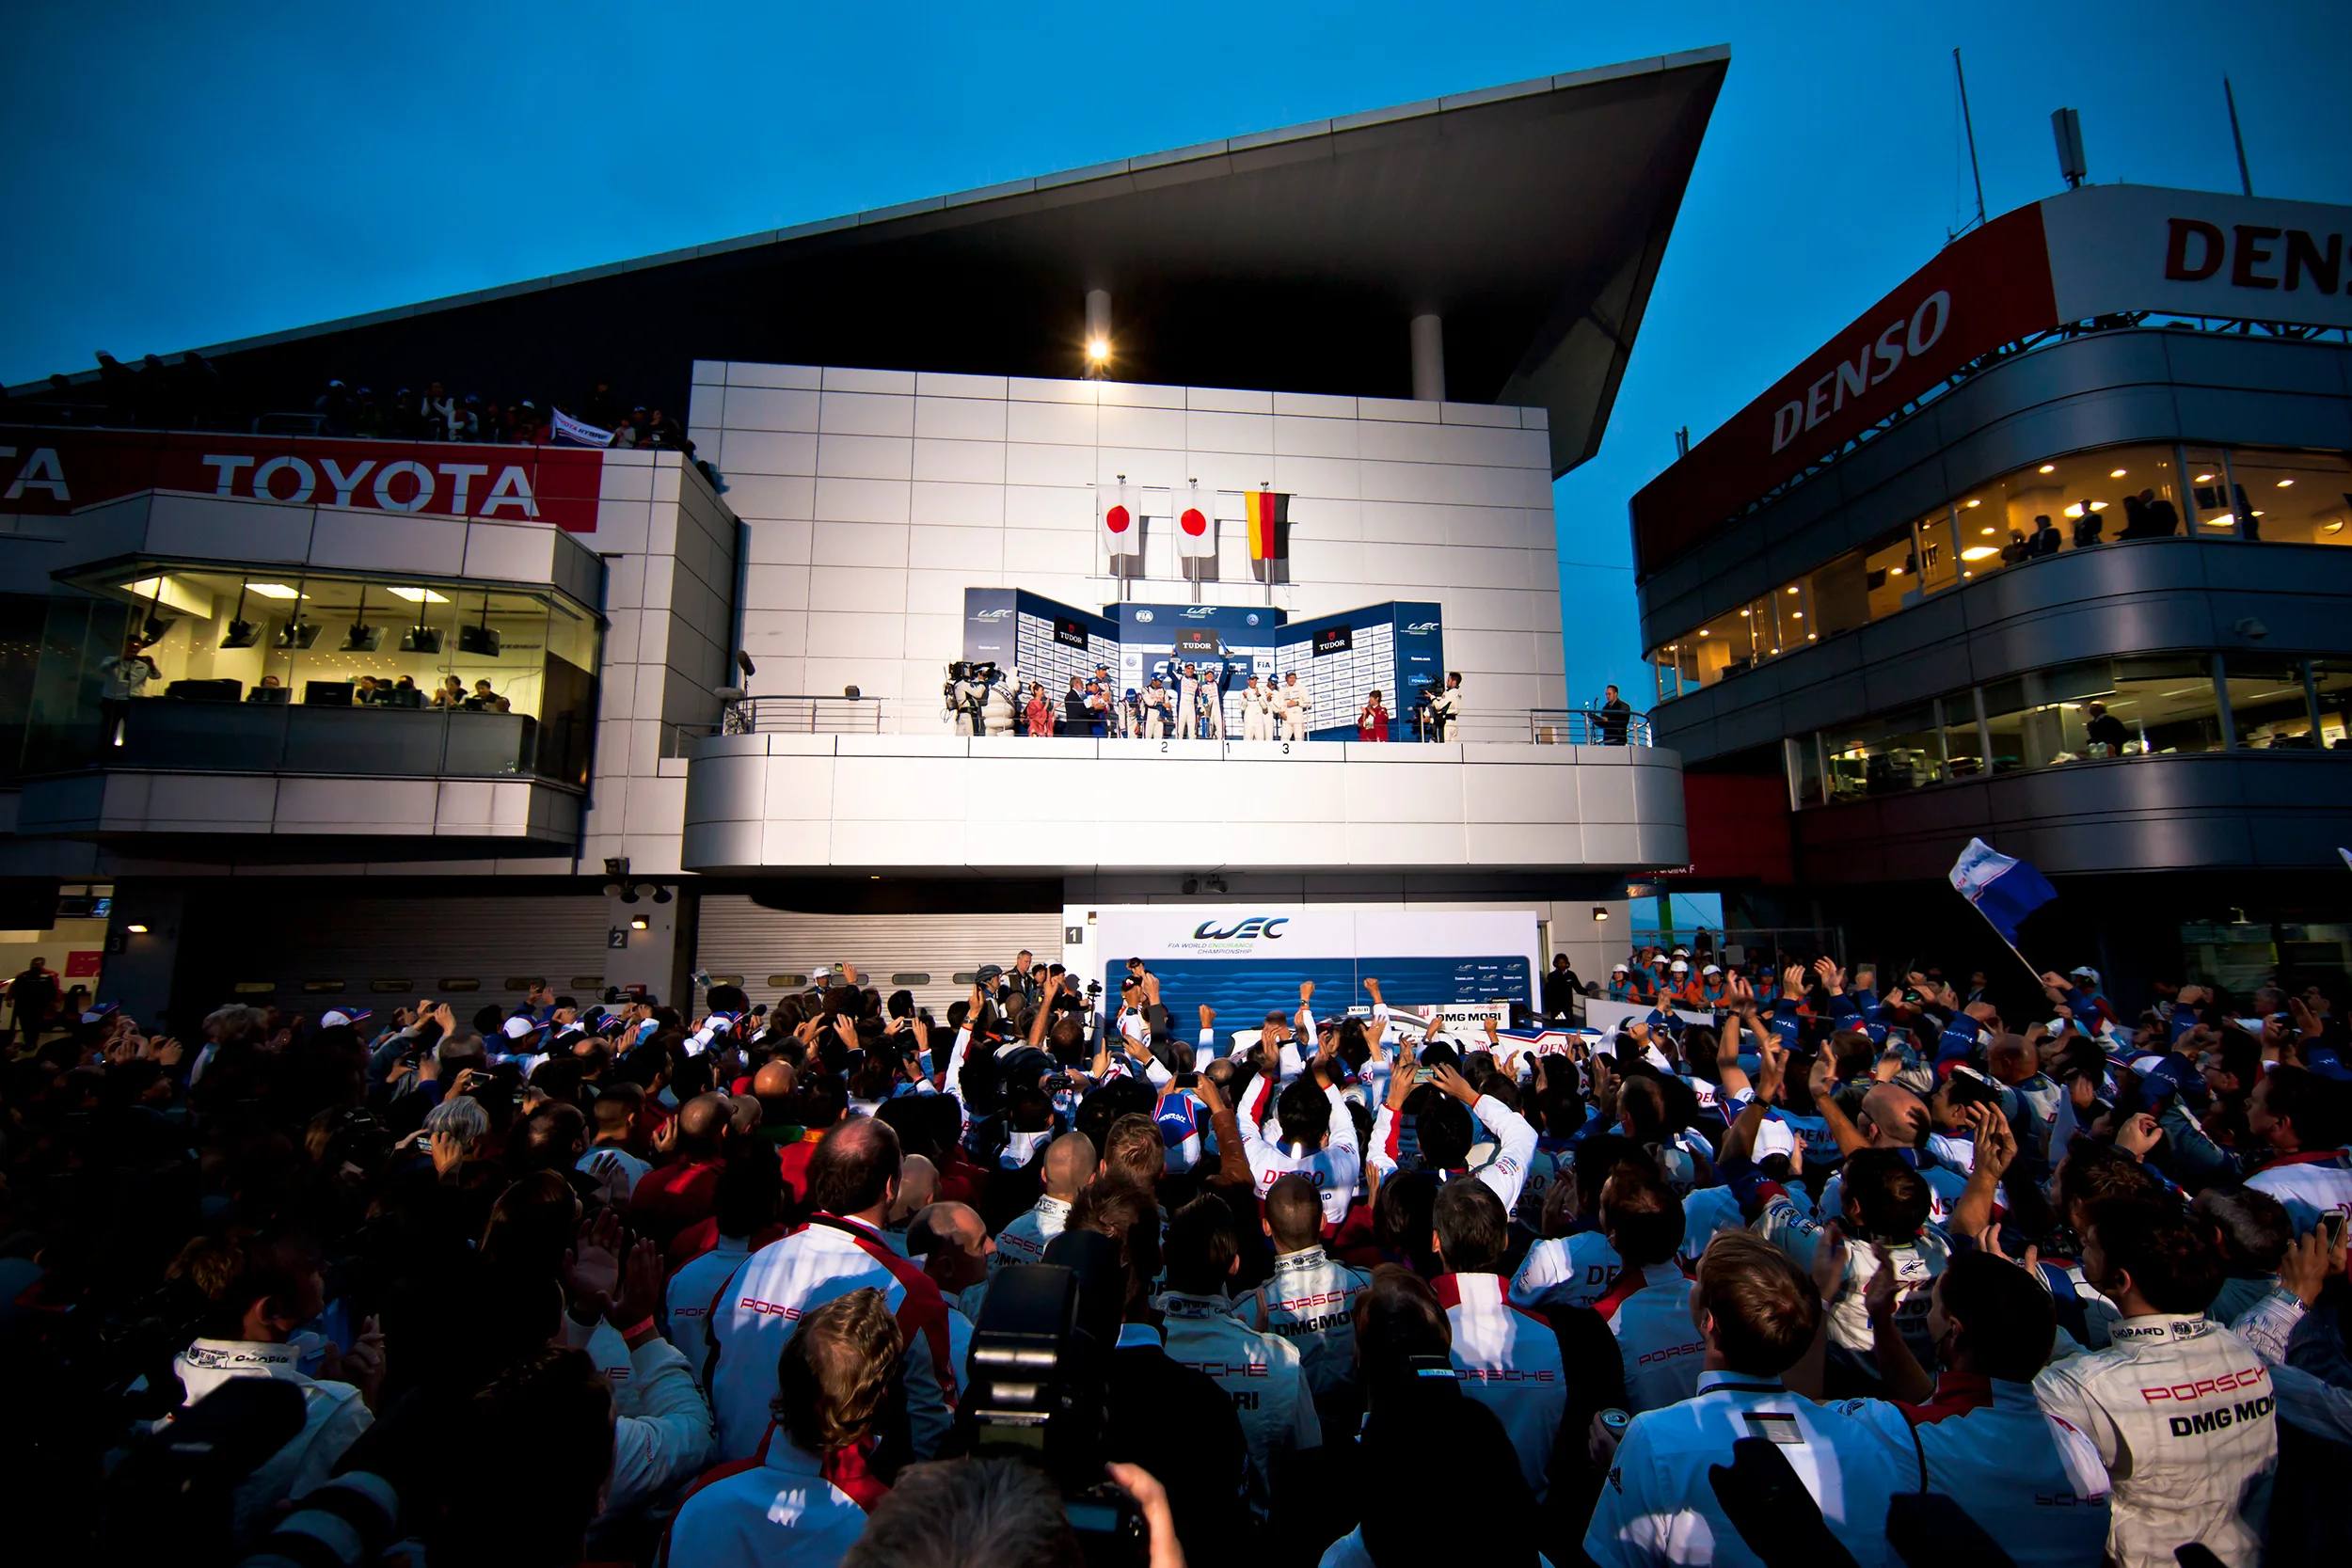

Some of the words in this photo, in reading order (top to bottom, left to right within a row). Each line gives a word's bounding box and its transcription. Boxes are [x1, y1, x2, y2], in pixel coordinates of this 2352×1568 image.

[2165, 217, 2352, 295] DEN
[1772, 290, 1950, 455] DENSO
[202, 454, 540, 516] TOYOTA
[1060, 631, 1083, 644] TUDOR
[1183, 641, 1212, 650] TUDOR
[1319, 640, 1345, 651] TUDOR
[1161, 741, 1168, 753] 2
[1226, 742, 1231, 753] 1
[1282, 743, 1290, 754] 3
[1070, 928, 1076, 942] 1
[1193, 916, 1290, 940] WEC
[110, 937, 121, 952] 3
[612, 932, 623, 946] 2
[1436, 1013, 1466, 1022] DMG
[740, 1298, 807, 1322] PORS
[1275, 1317, 1317, 1337] DMG
[1318, 1309, 1355, 1329] MO
[2111, 1327, 2164, 1339] CHOPARD
[2169, 1408, 2233, 1436] DMG
